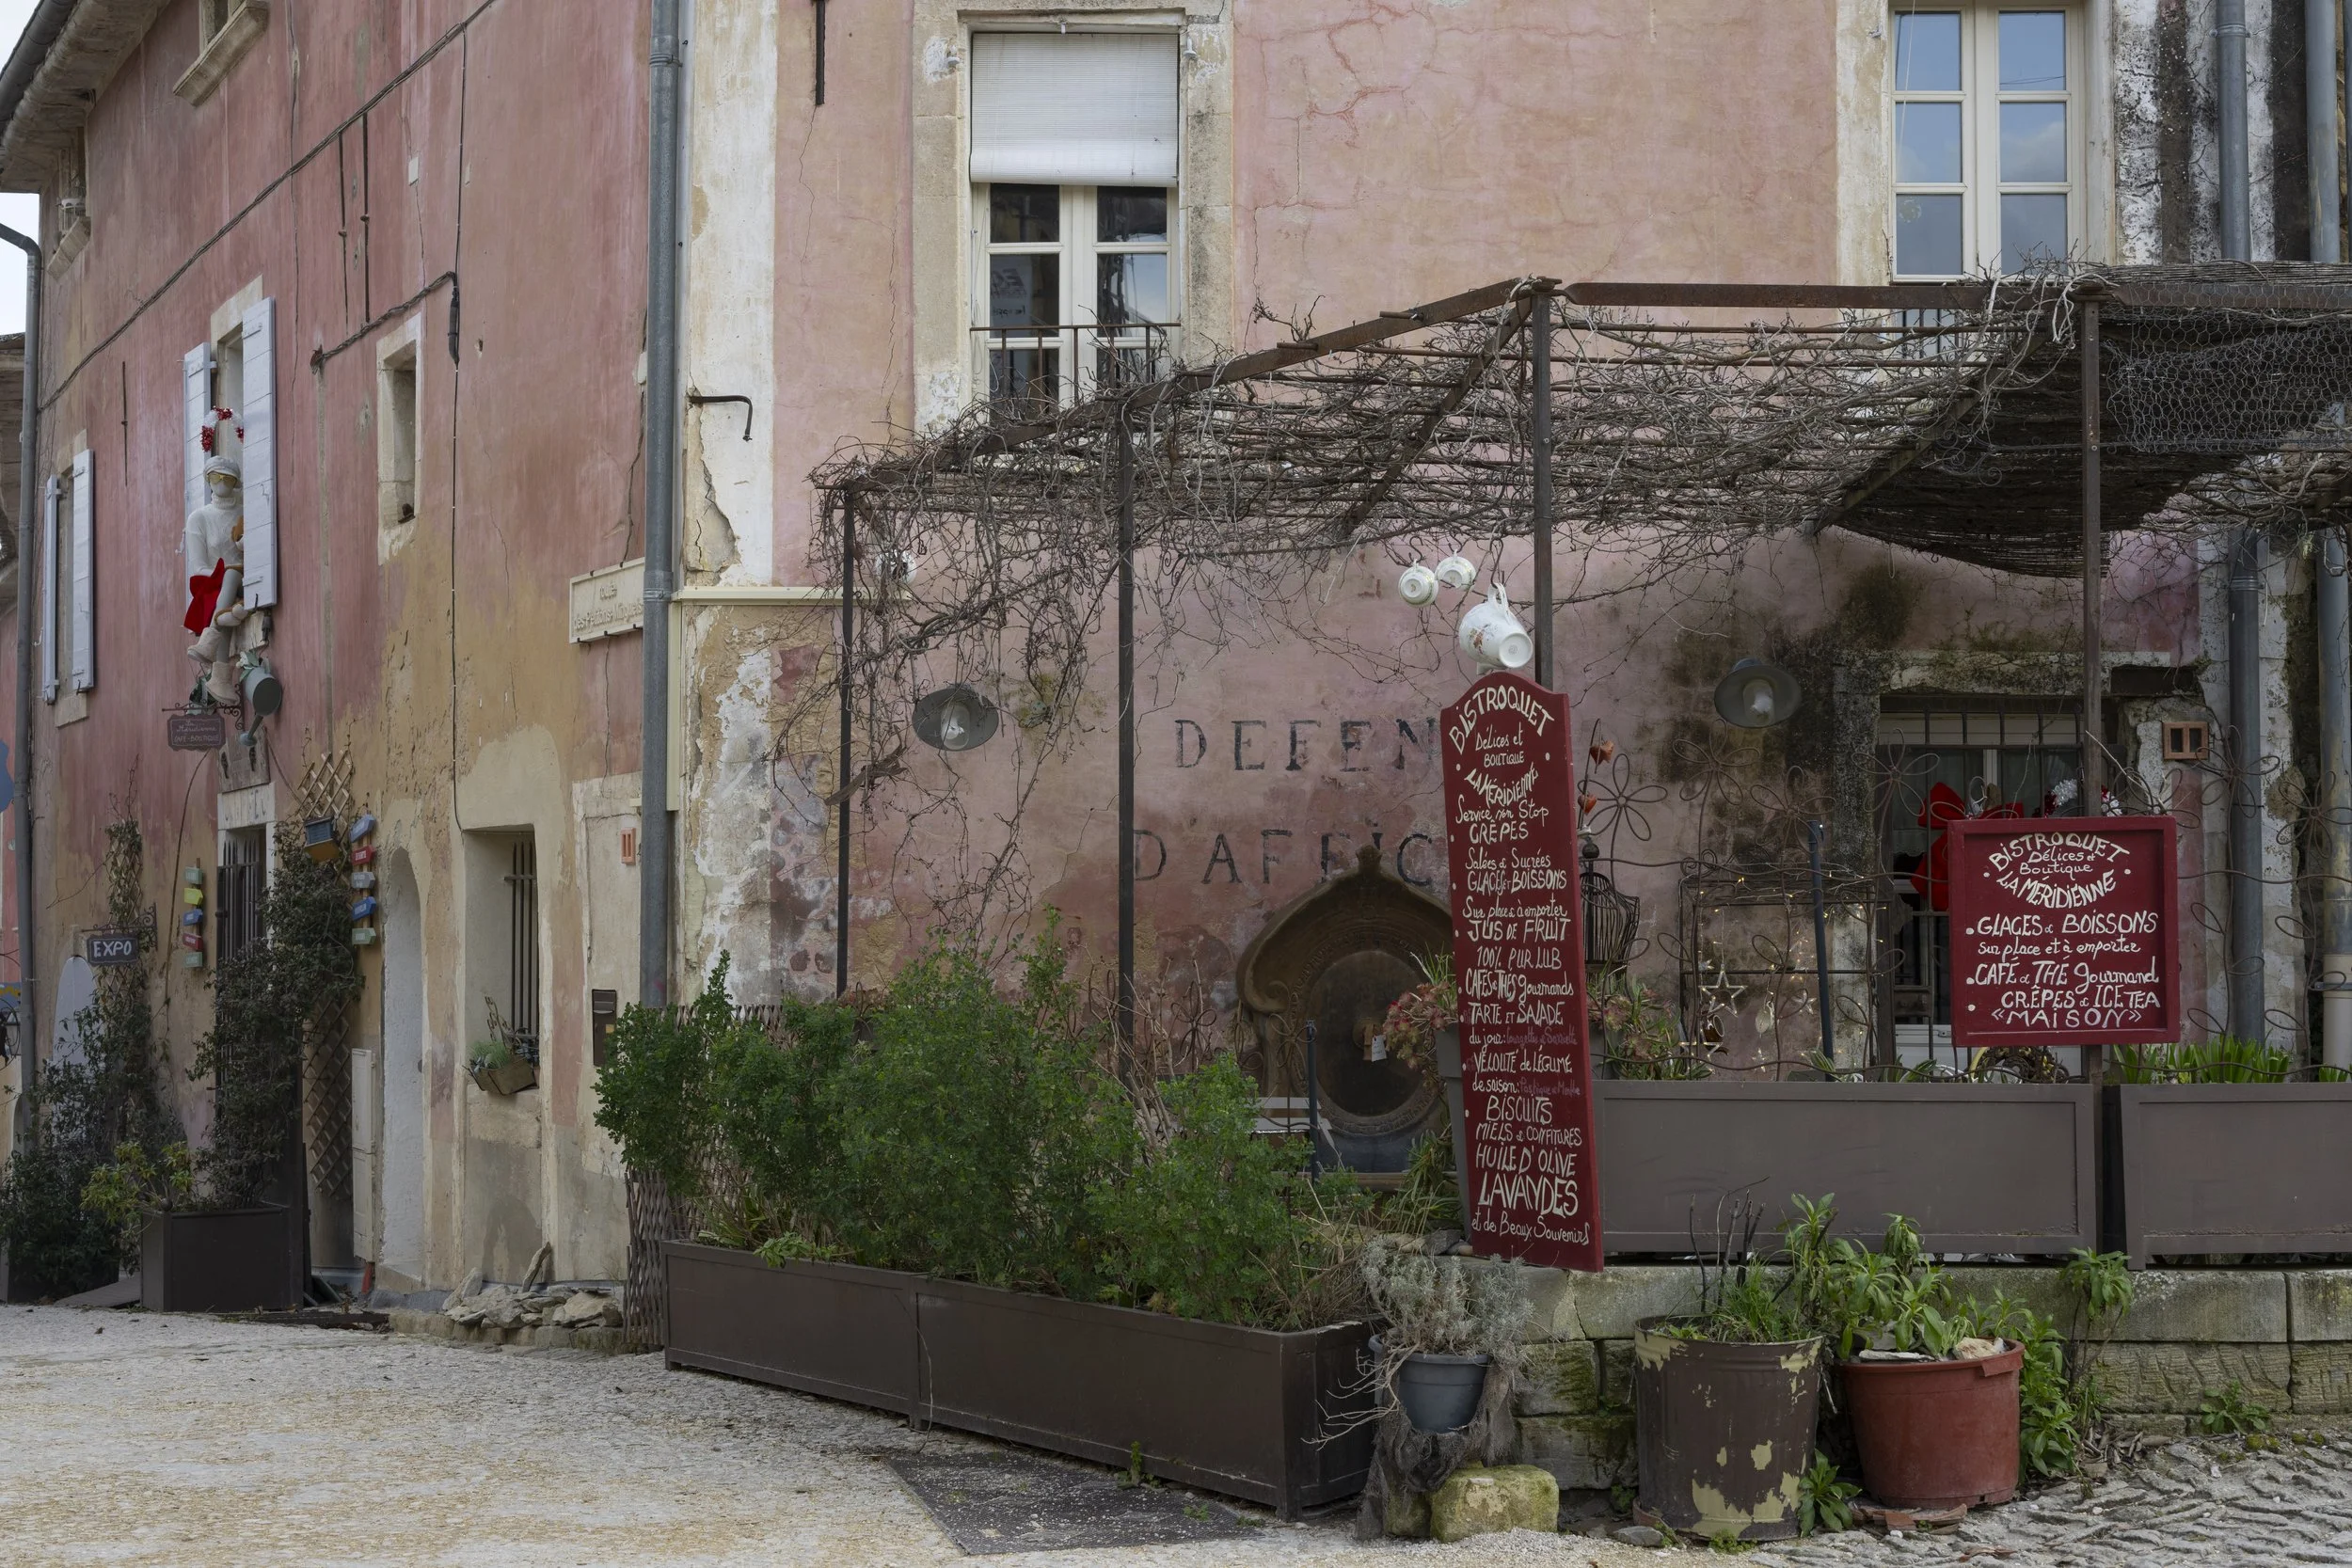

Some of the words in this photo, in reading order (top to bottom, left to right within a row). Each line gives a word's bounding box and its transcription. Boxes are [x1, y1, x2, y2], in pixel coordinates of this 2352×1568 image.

[1513, 721, 1523, 746] et
[1455, 794, 1492, 823] Service
[1518, 798, 1549, 827] Stop
[1470, 819, 1529, 845] CRÊPES
[1465, 846, 1497, 870] Salées
[1511, 847, 1551, 868] Sucrées
[2027, 846, 2085, 863] Délices
[2087, 853, 2096, 862] et
[1468, 869, 1506, 896] GLACES
[2019, 861, 2093, 880] Boutique
[1996, 871, 2019, 895] LA
[1462, 895, 1486, 919] Sur
[1517, 899, 1524, 917] à
[1468, 919, 1503, 942] JUS
[1506, 923, 1518, 941] DE
[1977, 913, 2043, 937] GLACES
[93, 941, 132, 958] EXPO
[1476, 945, 1502, 969] 100%
[1507, 947, 1534, 970] PUR
[1534, 946, 1562, 970] LUB
[2001, 936, 2042, 963] place
[2044, 938, 2061, 953] et
[2063, 940, 2073, 952] à
[2076, 934, 2141, 960] emporter
[1976, 957, 2021, 985] CAFÉ
[2032, 955, 2071, 986] THÉ
[2000, 984, 2075, 1008] CRÊPES
[2092, 984, 2124, 1008] ICE
[2122, 990, 2161, 1009] TEA
[1468, 1002, 1502, 1025] TARTE
[1505, 1012, 1516, 1024] ET
[1469, 1026, 1482, 1044] du
[1520, 1049, 1532, 1071] de
[1472, 1071, 1486, 1091] de
[1478, 1172, 1579, 1218] LAVANDES
[1471, 1207, 1482, 1231] et
[1484, 1208, 1497, 1232] de
[1500, 1211, 1533, 1242] Beaux
[1534, 1214, 1590, 1245] Souvenirs
